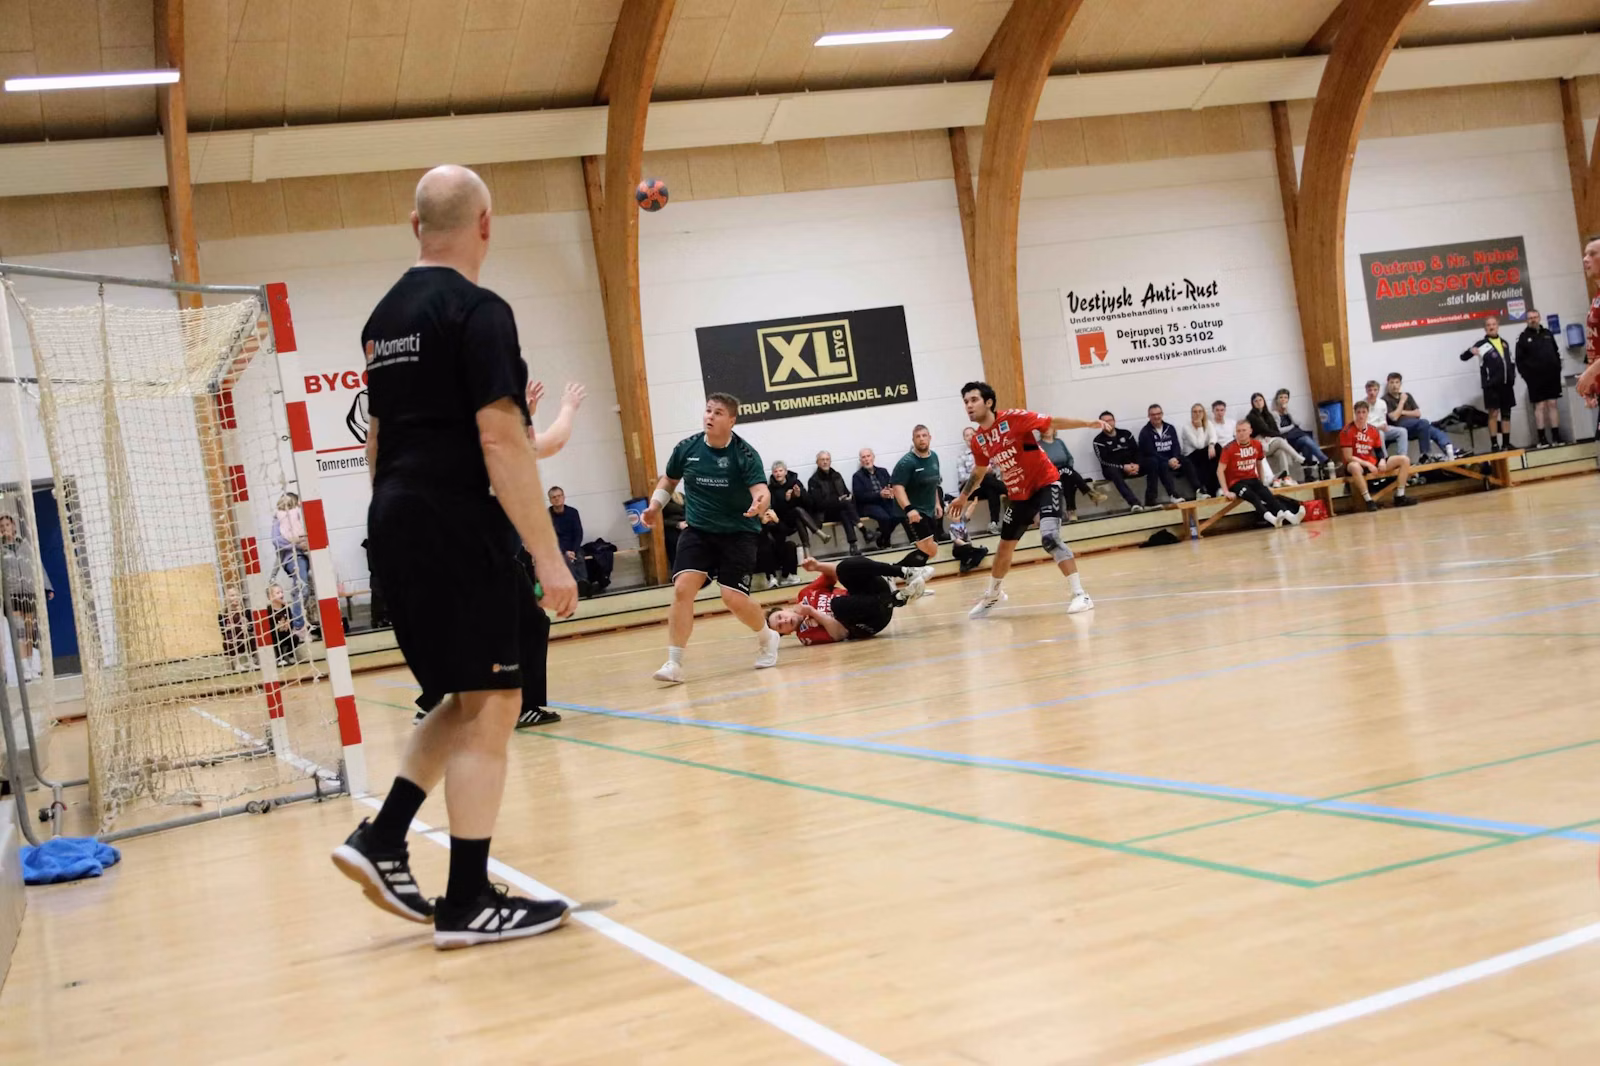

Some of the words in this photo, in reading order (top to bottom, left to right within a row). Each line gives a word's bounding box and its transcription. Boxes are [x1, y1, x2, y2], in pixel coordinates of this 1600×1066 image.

[1371, 259, 1427, 277] Outrup
[1431, 255, 1443, 270] &
[1447, 253, 1470, 269] Nr.
[1376, 265, 1520, 300] Autoservice
[1067, 286, 1133, 314] Vestjysk
[1141, 278, 1219, 308] Anti-Rust
[1466, 290, 1490, 303] lokal
[1491, 287, 1523, 300] kvalitet
[1070, 307, 1168, 324] Undervognsbehandling
[1177, 301, 1221, 312] særklasse
[1117, 324, 1164, 339] Dejrupvej
[1168, 322, 1179, 333] 75
[1190, 318, 1223, 330] Outrup
[375, 333, 420, 358] Momenti
[832, 329, 847, 358] BYG
[1131, 339, 1151, 350] Tlf.
[1152, 336, 1167, 348] 30
[1169, 334, 1184, 346] 33
[766, 330, 849, 383] XL
[1121, 344, 1228, 365] www.vestjysk-antirust.dk
[773, 388, 881, 412] TØMMERHANDEL
[885, 384, 909, 398] A/S
